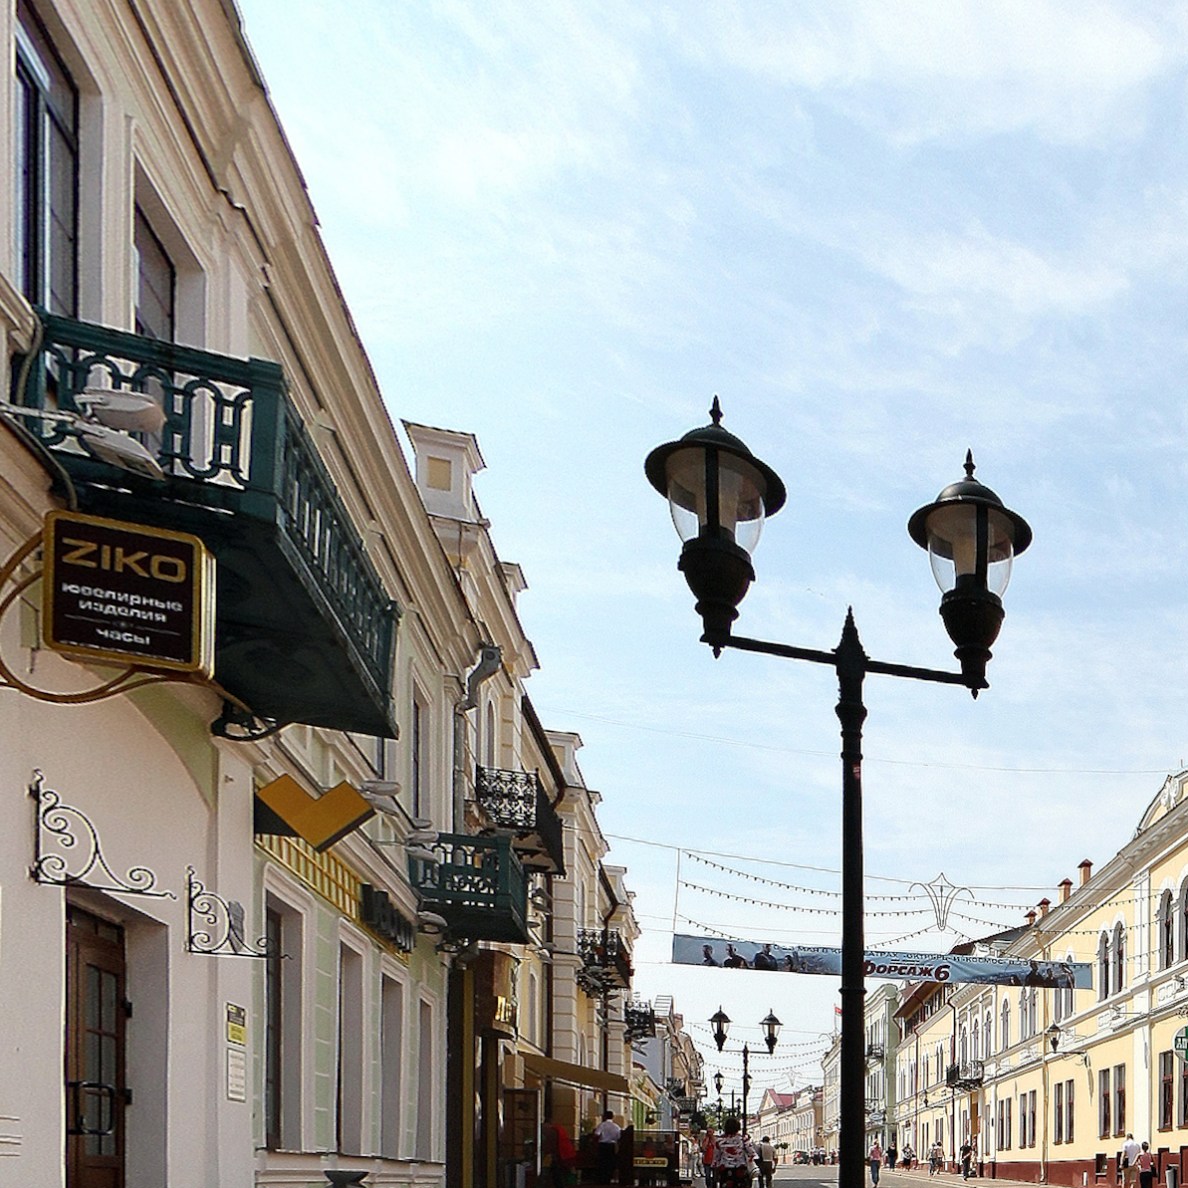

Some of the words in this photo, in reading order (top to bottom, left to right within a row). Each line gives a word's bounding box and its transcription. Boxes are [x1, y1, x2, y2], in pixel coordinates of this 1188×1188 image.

[62, 537, 187, 583] ZIKO
[62, 582, 184, 612] ювелирные
[78, 600, 167, 622] изделия
[96, 628, 150, 645] часы
[935, 964, 950, 981] 6
